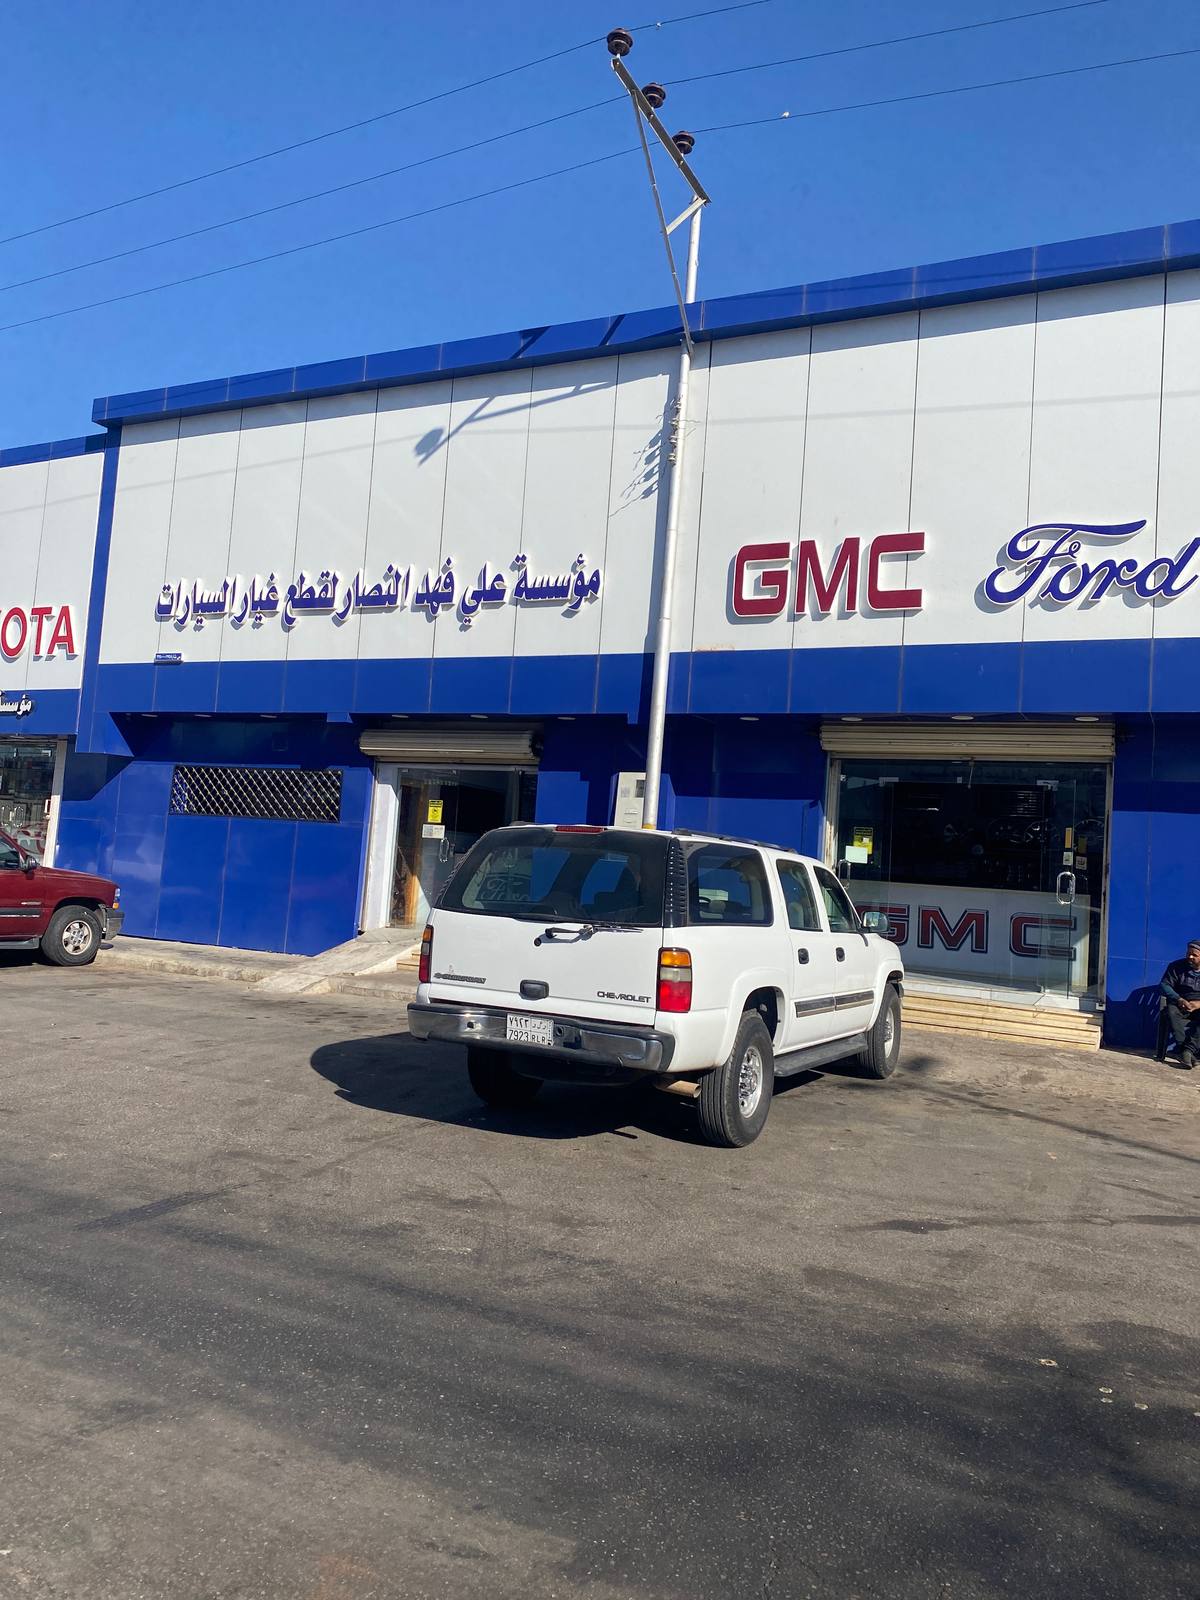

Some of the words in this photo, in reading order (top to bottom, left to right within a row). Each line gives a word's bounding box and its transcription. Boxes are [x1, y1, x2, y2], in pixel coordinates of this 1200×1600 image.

[414, 557, 456, 616] فهد
[513, 553, 601, 611] مؤسسة
[732, 532, 926, 617] GMC
[984, 518, 1200, 605] Ford
[156, 576, 235, 627] السيارات
[233, 572, 280, 625] غيار
[285, 569, 338, 627] لقطع
[337, 563, 412, 623] النصار
[461, 562, 507, 626] علي
[0, 606, 75, 658] OTA
[0, 690, 32, 715] مؤسس
[596, 990, 652, 1003] CHEVROLET
[508, 1029, 529, 1042] 7923
